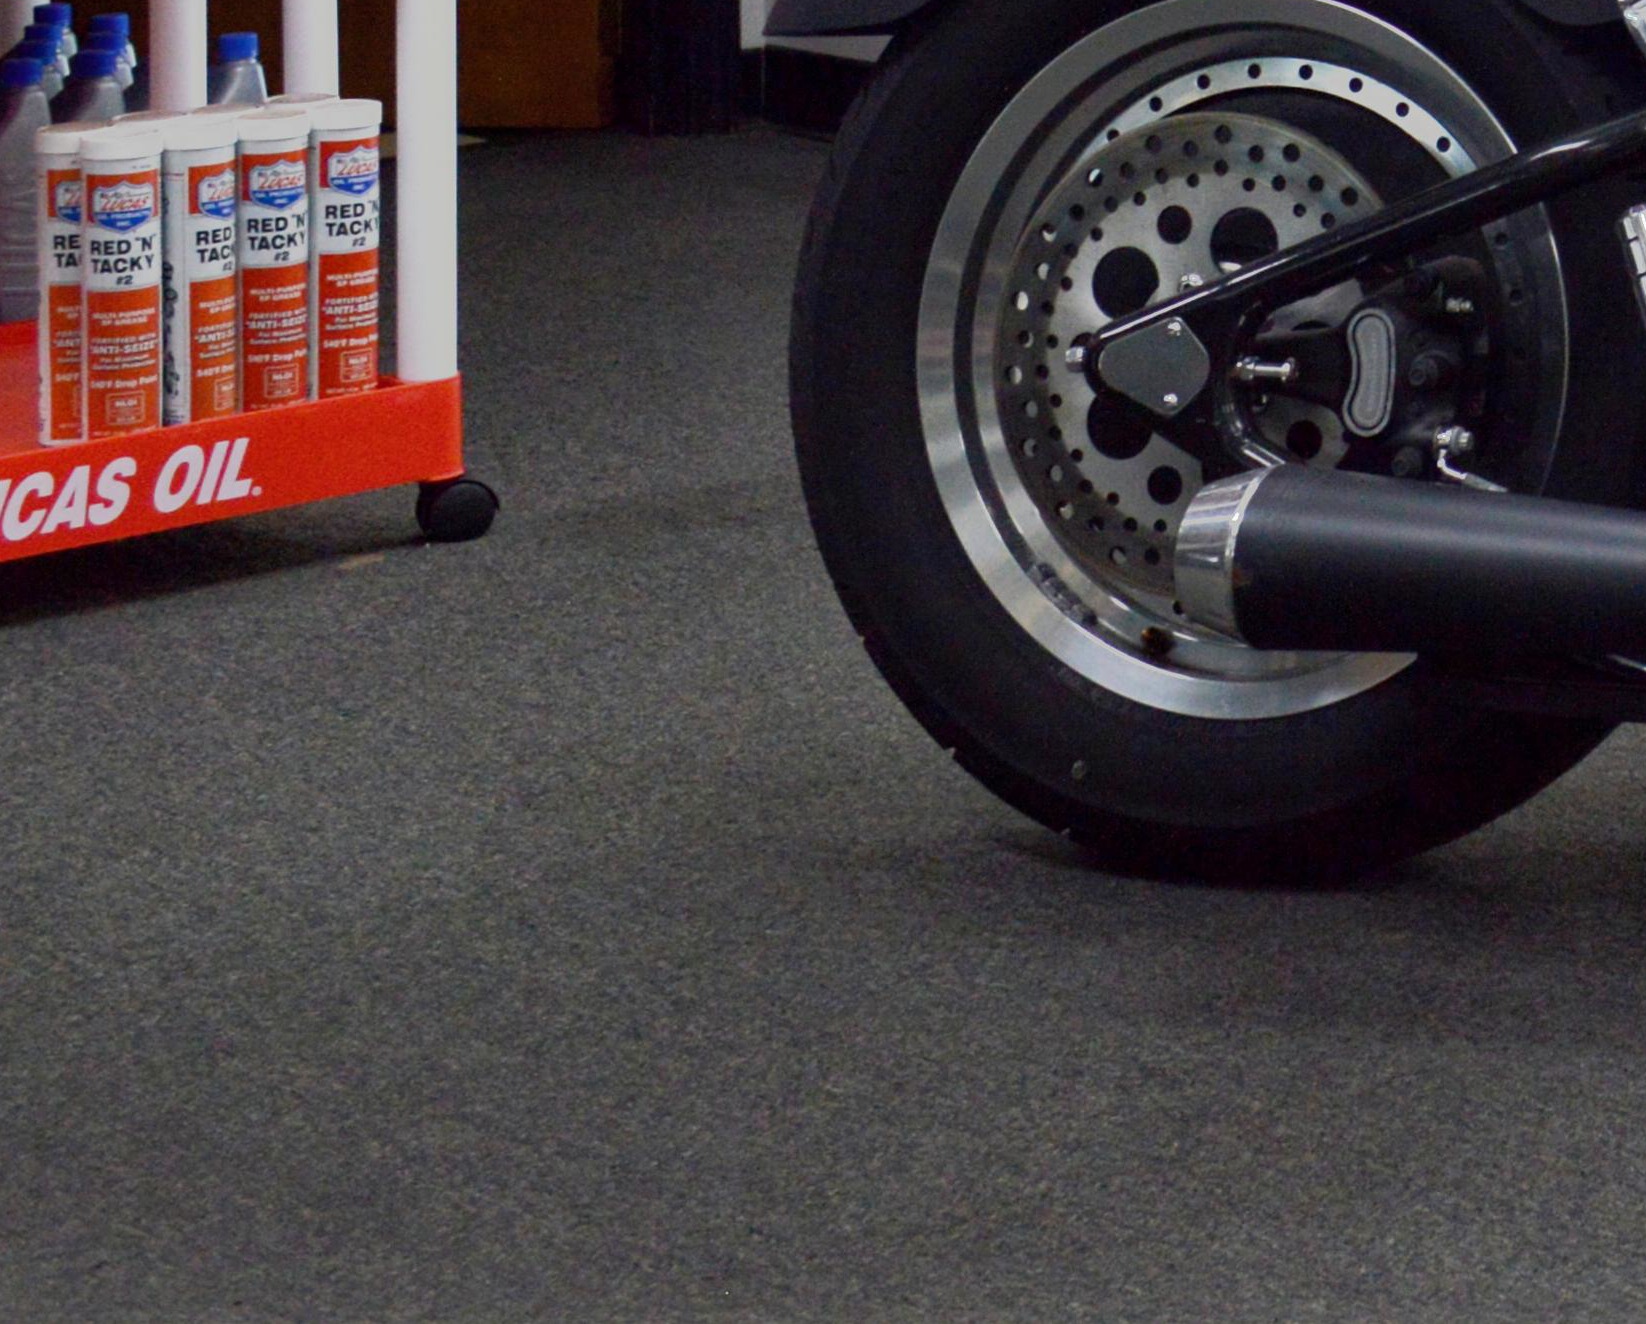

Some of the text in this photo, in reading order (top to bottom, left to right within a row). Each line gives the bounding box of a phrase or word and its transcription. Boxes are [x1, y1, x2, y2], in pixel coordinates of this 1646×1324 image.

[325, 202, 365, 220] RED
[247, 216, 288, 234] RED
[54, 234, 81, 250] RE
[196, 226, 232, 247] RED
[248, 232, 306, 252] TACKY
[352, 235, 367, 247] #2
[90, 239, 131, 256] RED
[197, 244, 232, 264] TAC
[273, 250, 290, 263] #2
[91, 254, 155, 276] TACKY
[115, 274, 134, 286] #2
